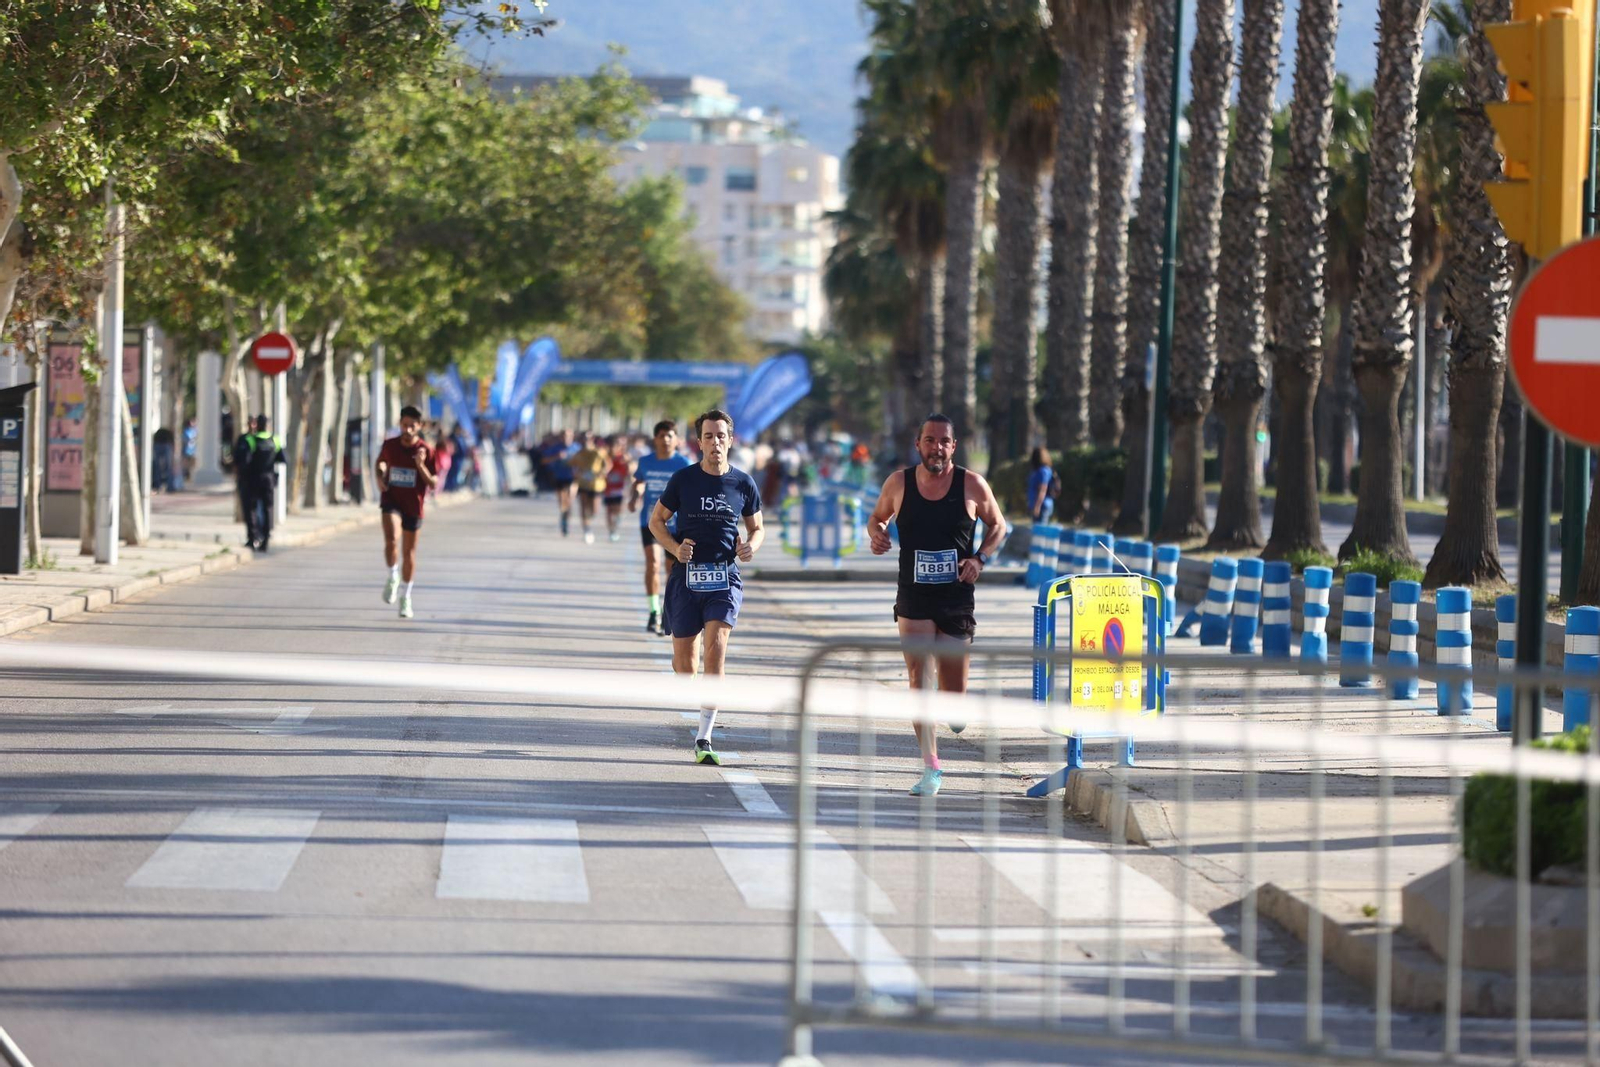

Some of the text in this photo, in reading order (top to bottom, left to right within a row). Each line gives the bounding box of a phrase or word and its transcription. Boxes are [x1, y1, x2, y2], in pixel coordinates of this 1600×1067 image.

[3, 419, 17, 436] P
[920, 563, 952, 572] 1881
[692, 572, 723, 581] 1519
[1086, 583, 1141, 597] POLICÍA LOCAL
[1098, 601, 1130, 615] MÁLAGA
[1074, 666, 1097, 675] PROHIBIDO
[1126, 666, 1140, 674] DESDE
[1073, 686, 1082, 694] LAS
